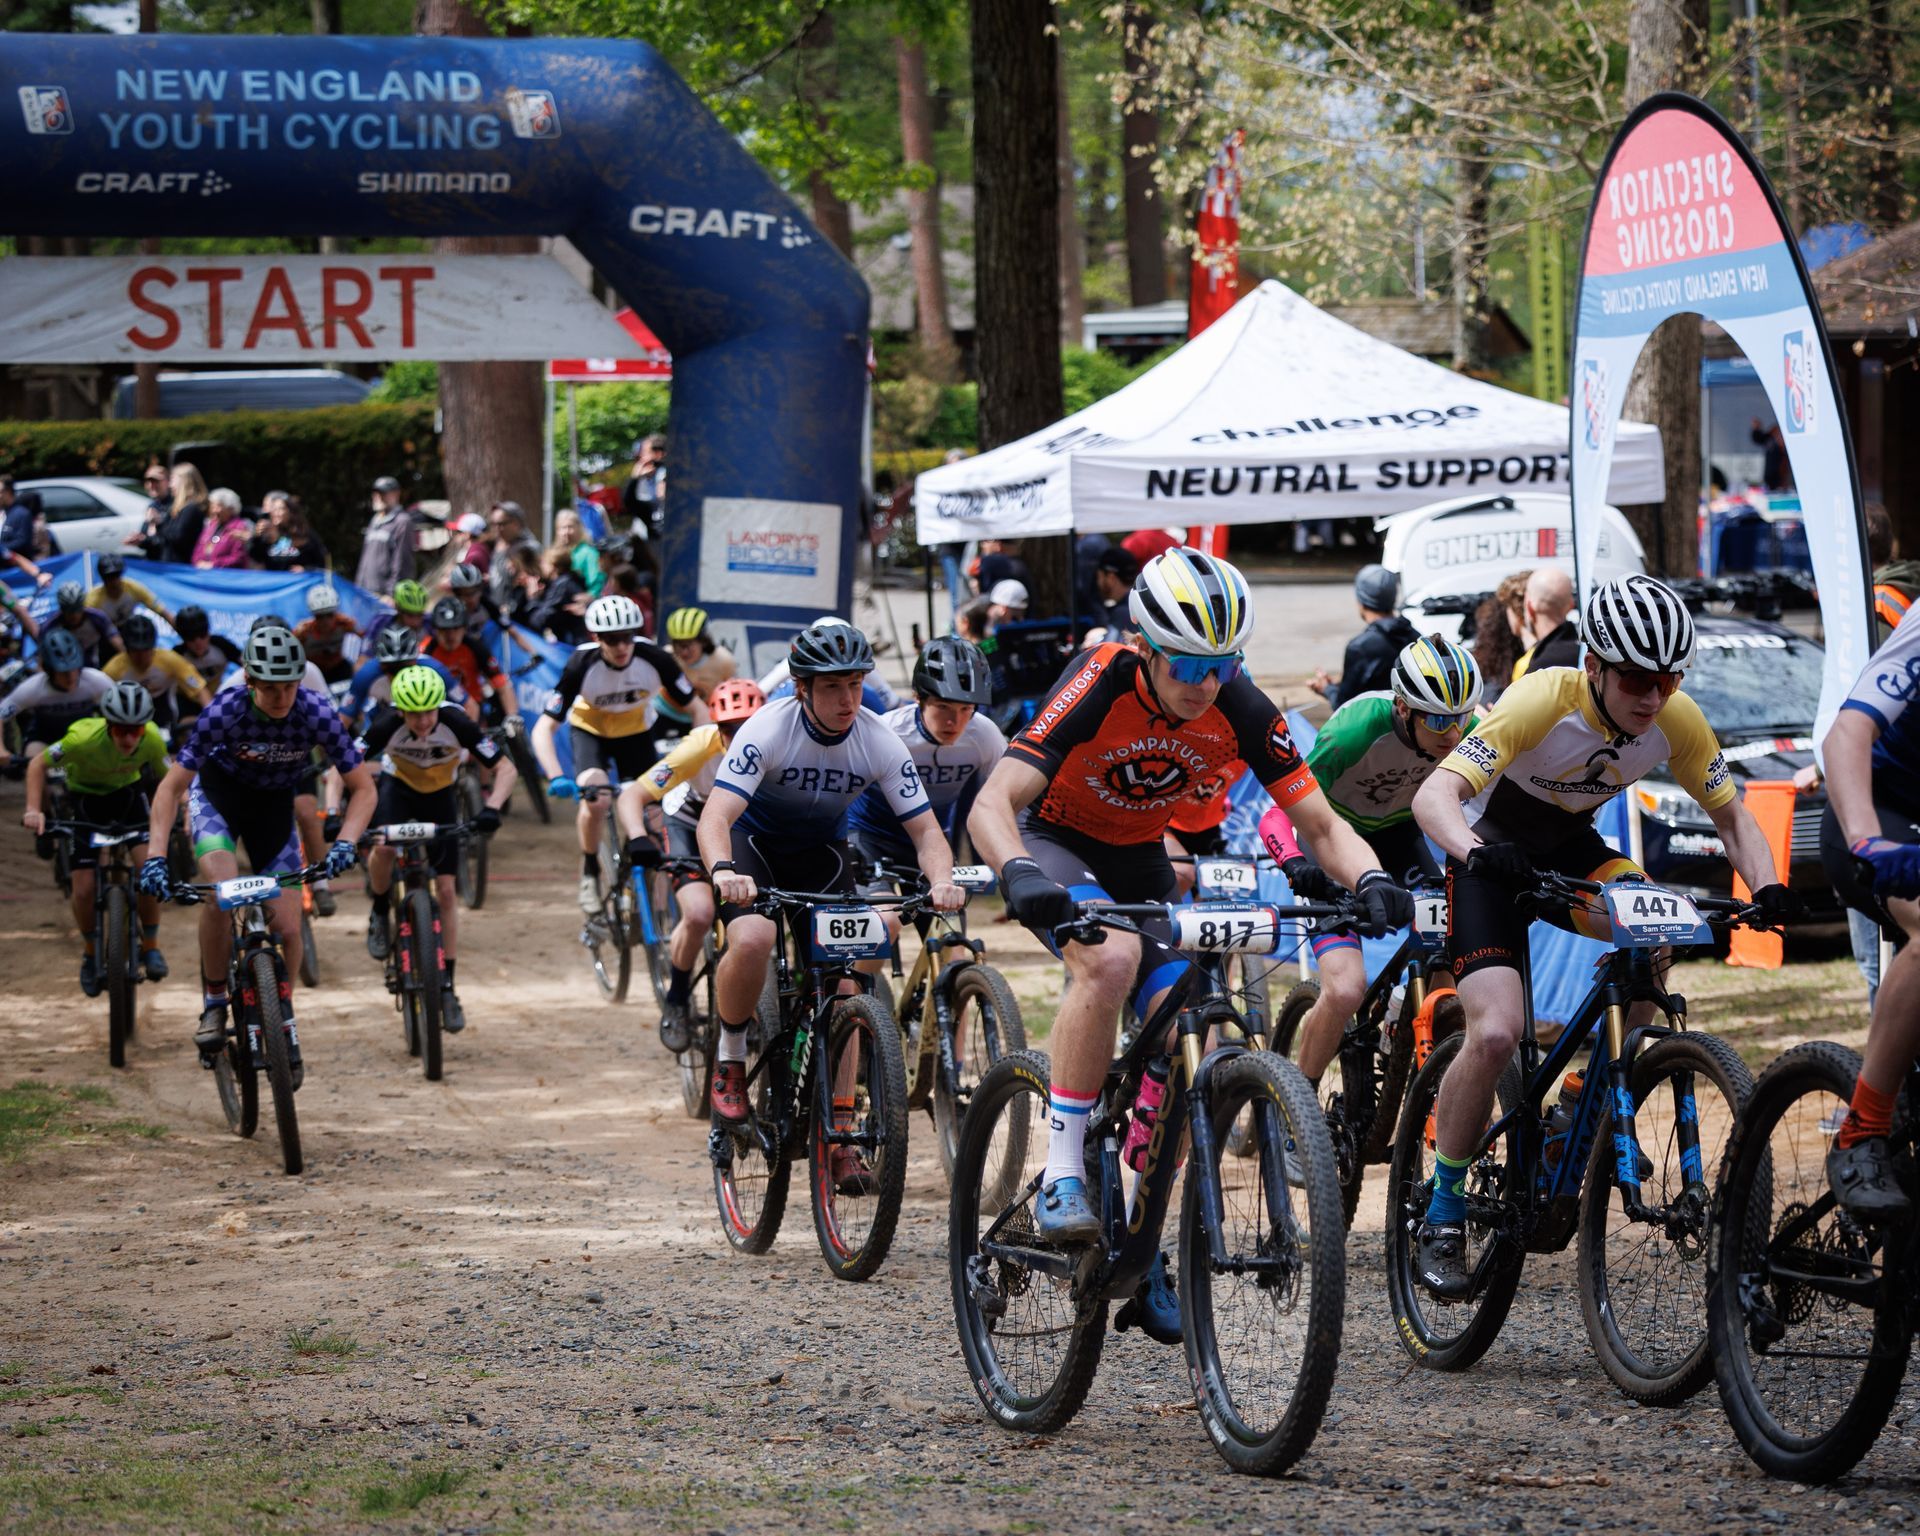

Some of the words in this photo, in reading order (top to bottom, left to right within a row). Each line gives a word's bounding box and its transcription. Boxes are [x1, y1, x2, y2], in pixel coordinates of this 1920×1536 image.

[116, 70, 228, 101] NEW
[241, 70, 482, 101] ENGLAND
[100, 113, 270, 150] YOUTH
[283, 113, 502, 151] CYCLING
[76, 172, 199, 194] CRAFT
[357, 172, 512, 194] SHIMANO
[628, 205, 778, 240] CRAFT
[126, 266, 436, 350] START
[1191, 403, 1480, 443] challenge
[1147, 460, 1360, 499] NEUTRAL
[1376, 454, 1571, 493] SUPPORT
[1425, 531, 1538, 568] RACING
[1596, 619, 1614, 649] LAZER
[1031, 660, 1102, 736] WARRIORS
[1098, 736, 1209, 773] WOMPATUCK
[776, 767, 866, 794] PREP
[917, 764, 975, 785] REP
[1531, 777, 1630, 793] GNARGONAUT
[232, 879, 265, 892] 308
[1213, 868, 1243, 882] 847
[1632, 896, 1679, 917] 447
[829, 919, 870, 939] 687
[1198, 920, 1255, 948] 817
[1014, 1067, 1048, 1096] MAXX
[1399, 1316, 1430, 1356] MAXXIS
